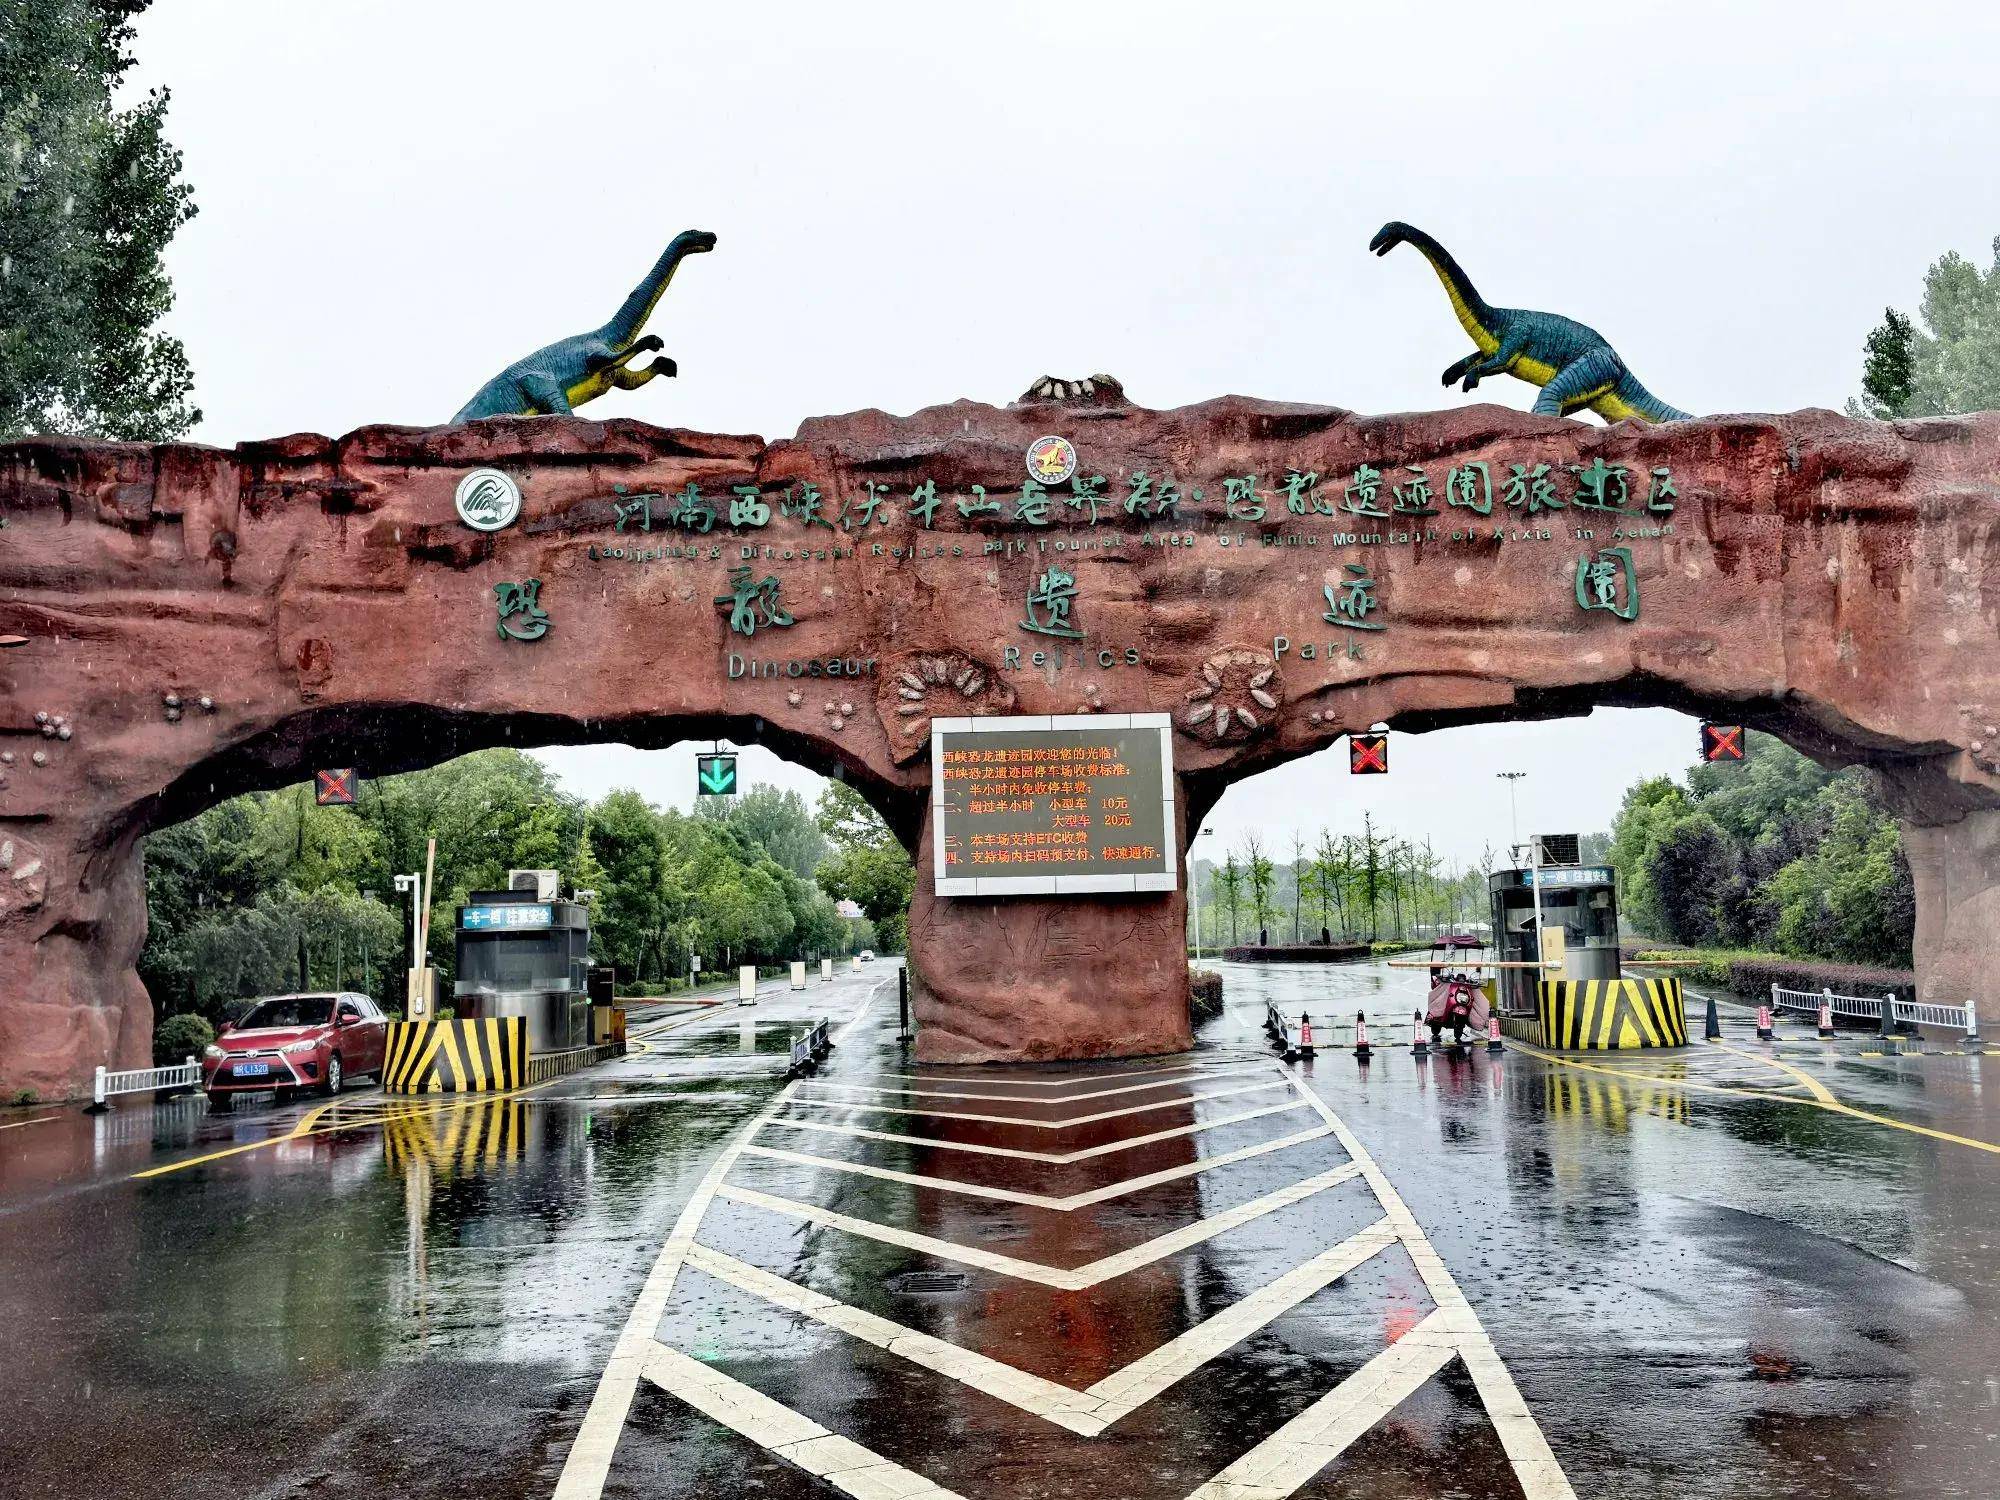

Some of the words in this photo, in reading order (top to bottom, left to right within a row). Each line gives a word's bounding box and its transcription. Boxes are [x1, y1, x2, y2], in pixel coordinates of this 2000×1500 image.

[710, 545, 721, 559] &
[872, 544, 962, 559] Relics
[1037, 533, 1122, 552] Tourist
[1141, 531, 1195, 547] Area
[1219, 532, 1246, 547] of
[1452, 526, 1475, 541] of
[1493, 526, 1551, 541] Xixia
[1577, 525, 1594, 540] in
[728, 653, 876, 679] Dinosaur
[1003, 646, 1140, 671] Relics
[1273, 635, 1364, 662] Park
[1049, 798, 1089, 812] 小型车
[1102, 797, 1129, 810] 10元
[1052, 814, 1091, 829] 大型车
[1104, 813, 1132, 827] 20元
[945, 831, 1088, 848] 三、本车场支持ETC收费
